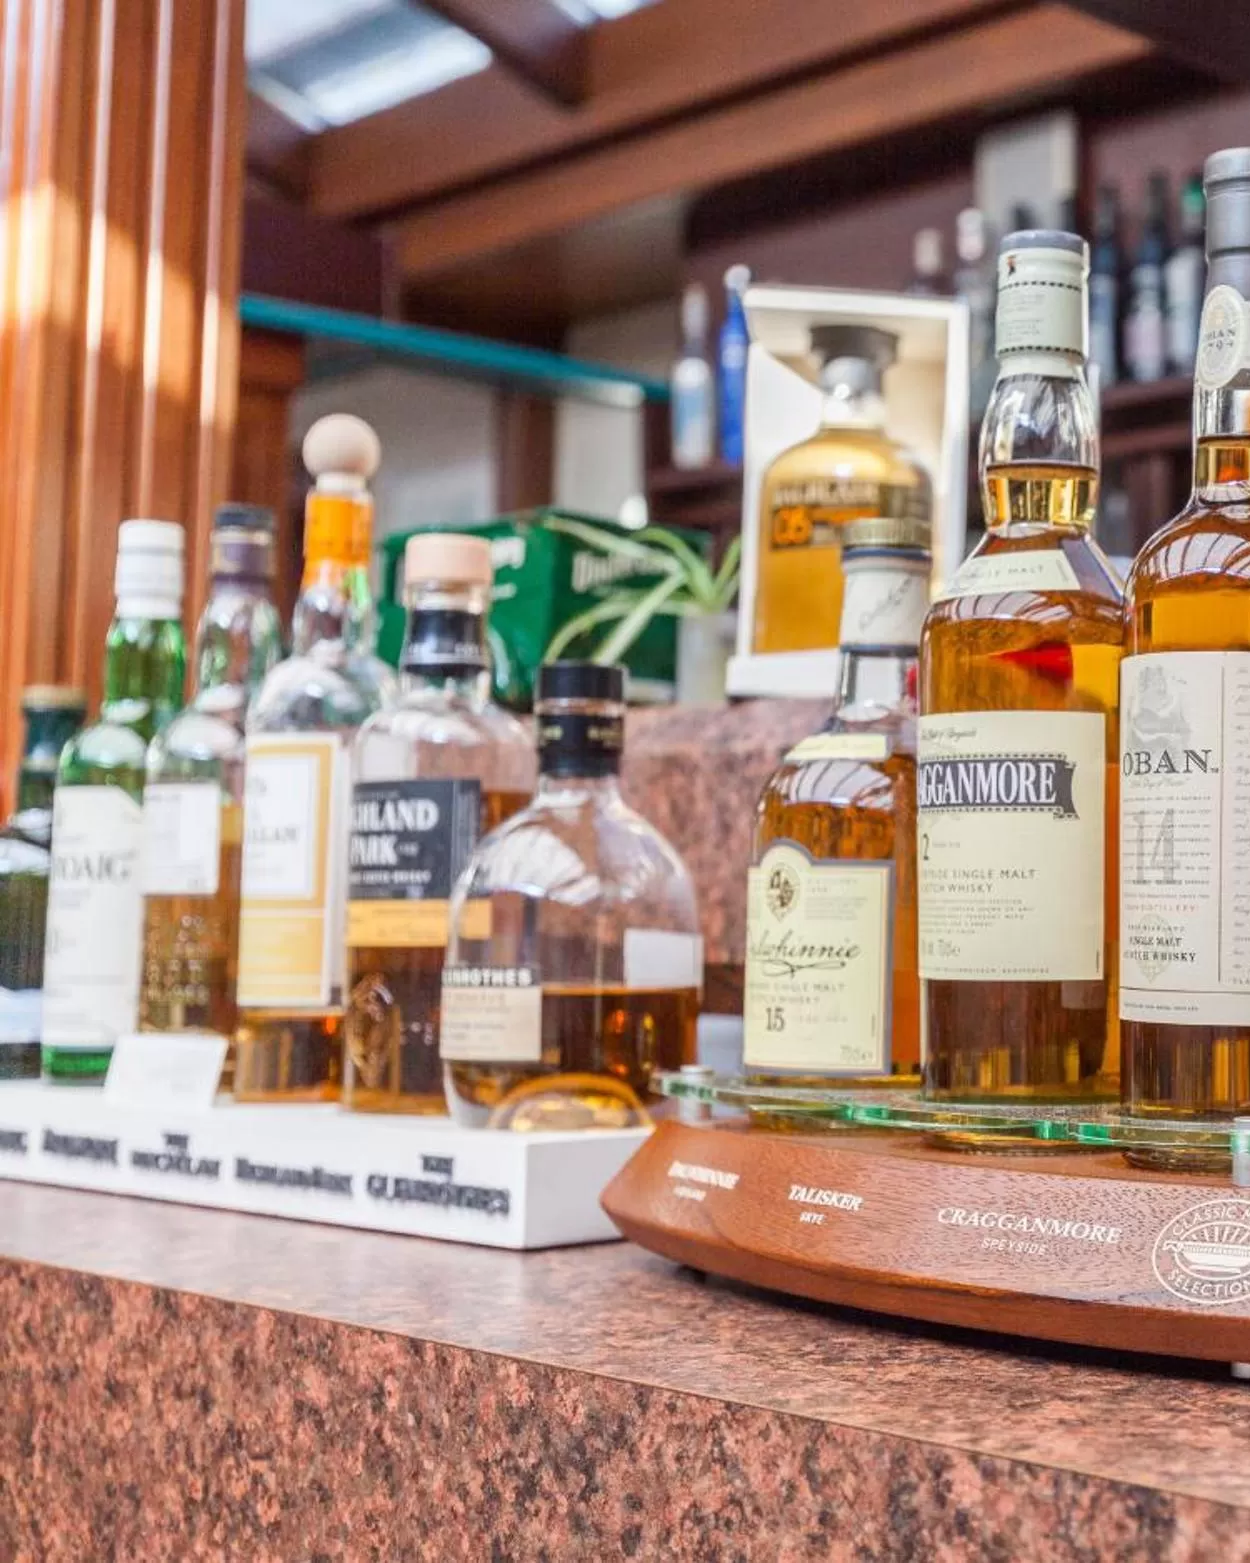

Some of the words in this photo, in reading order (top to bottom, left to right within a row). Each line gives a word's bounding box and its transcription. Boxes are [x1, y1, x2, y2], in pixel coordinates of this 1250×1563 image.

[1000, 869, 1037, 880] MALT
[948, 883, 993, 893] WHISKY
[1152, 951, 1196, 962] WHISKY
[766, 1007, 785, 1032] 15
[787, 1184, 864, 1212] TALISKER
[937, 1206, 1122, 1245] CRAGGANMORE
[1172, 1205, 1238, 1237] CLASSIC
[981, 1237, 1048, 1256] SPEYSIDE
